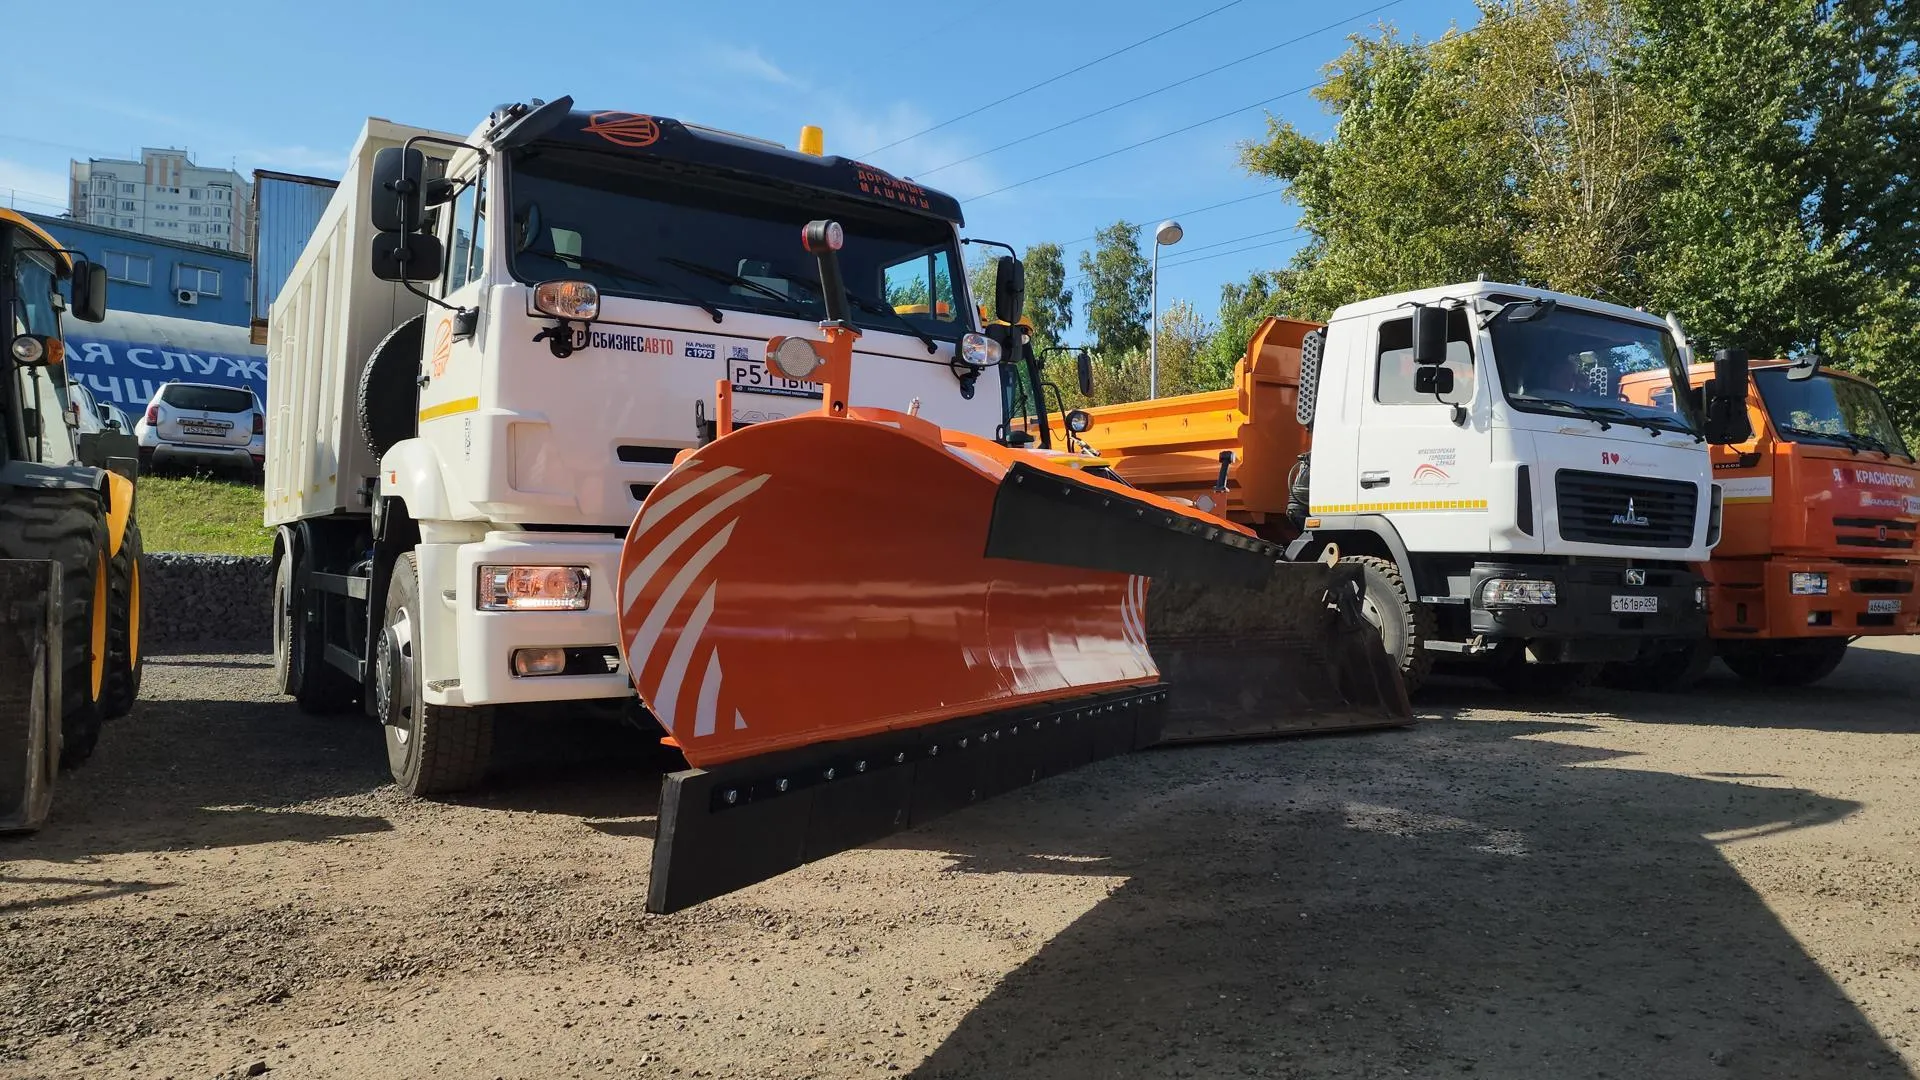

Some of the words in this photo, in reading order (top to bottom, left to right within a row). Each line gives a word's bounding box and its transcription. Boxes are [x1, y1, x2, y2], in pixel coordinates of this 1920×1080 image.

[858, 170, 926, 196] ДОРОЖНЫЕ
[859, 182, 930, 210] МАШИНЫ
[126, 348, 268, 381] СЛУЖ
[693, 349, 713, 359] 1993
[1602, 452, 1610, 465] Я
[1832, 468, 1842, 482] Я
[1855, 469, 1916, 489] КРАСНОГОРСК
